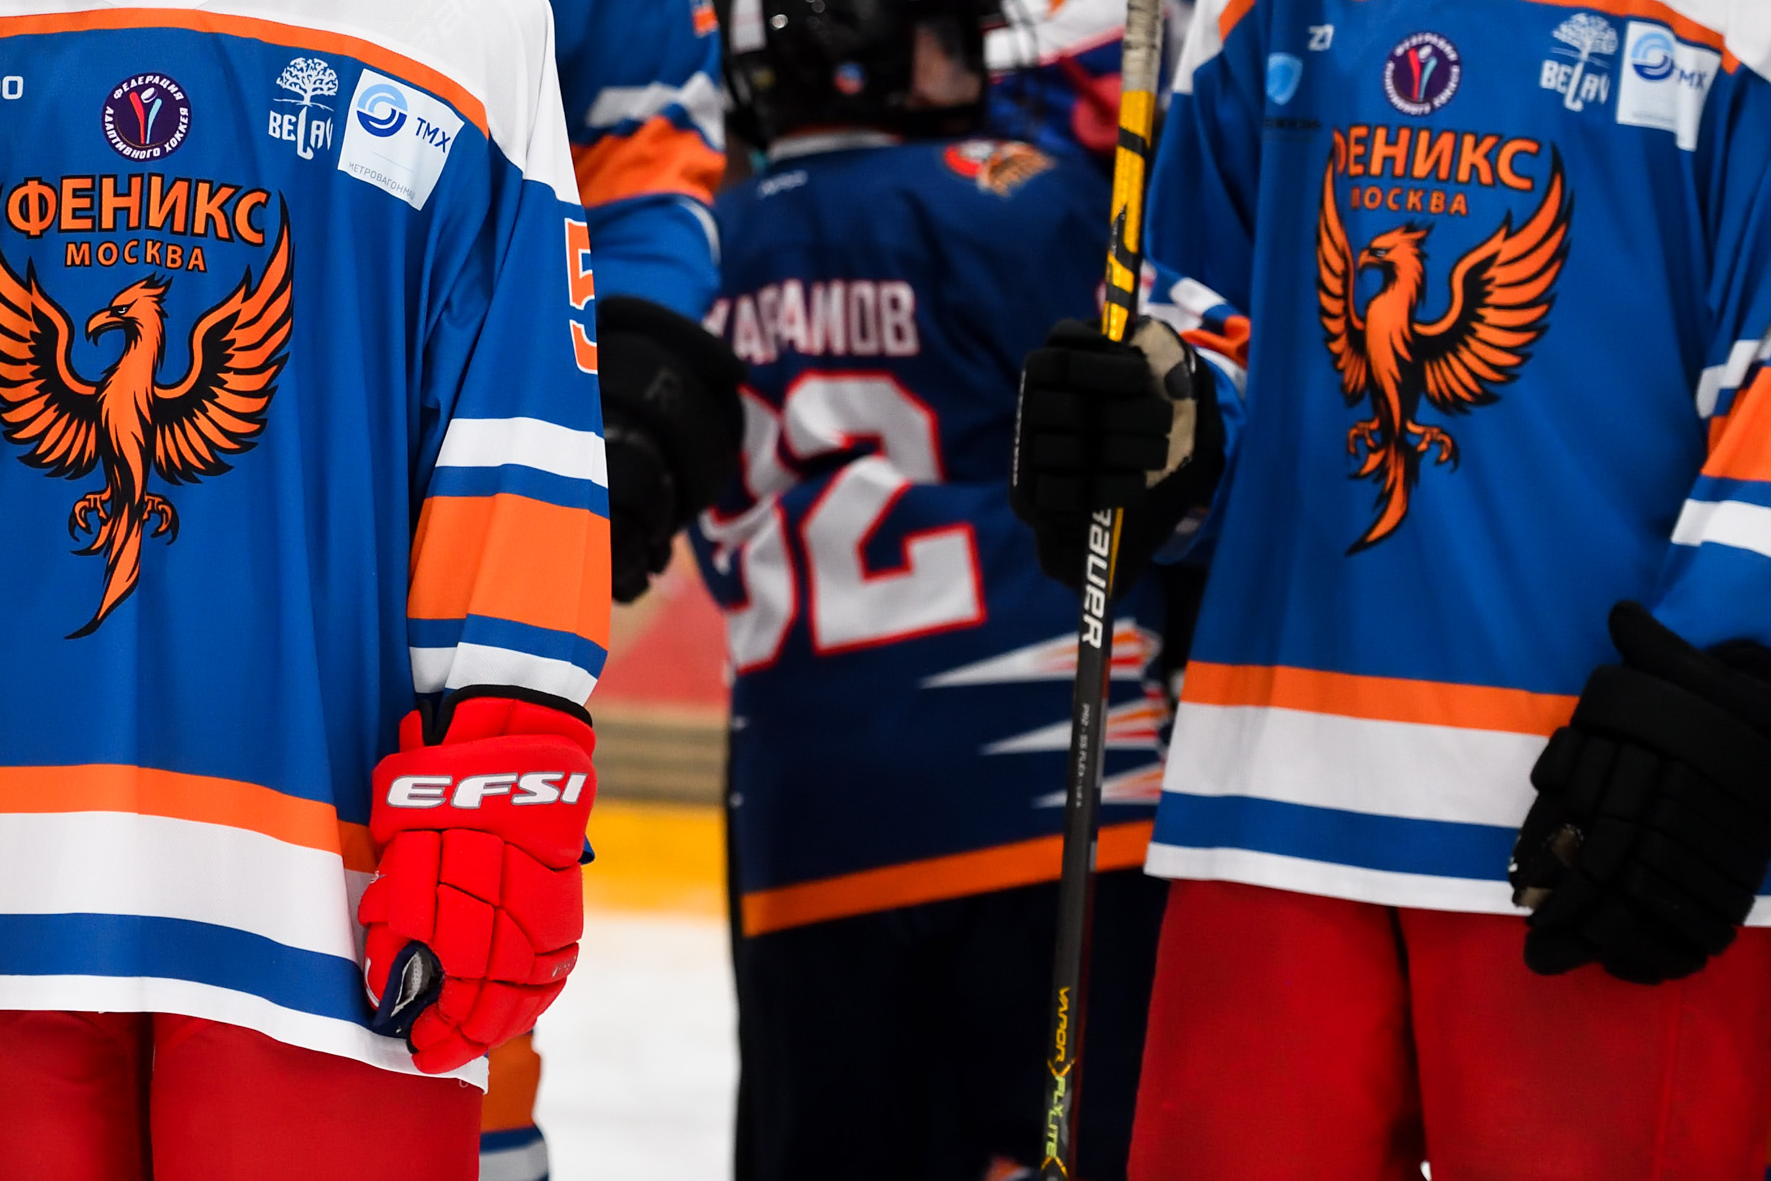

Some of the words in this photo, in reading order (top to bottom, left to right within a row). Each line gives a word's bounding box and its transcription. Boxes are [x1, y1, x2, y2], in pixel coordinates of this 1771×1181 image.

[113, 75, 184, 101] ФЕДЕРАЦИЯ
[104, 106, 161, 159] АДАПТИВНОГО
[163, 107, 189, 153] ХОККЕЯ
[6, 172, 271, 247] ФЕНИКС
[65, 239, 207, 272] МОСКВА
[387, 772, 588, 809] EFSI
[1055, 985, 1072, 1063] VAPOR
